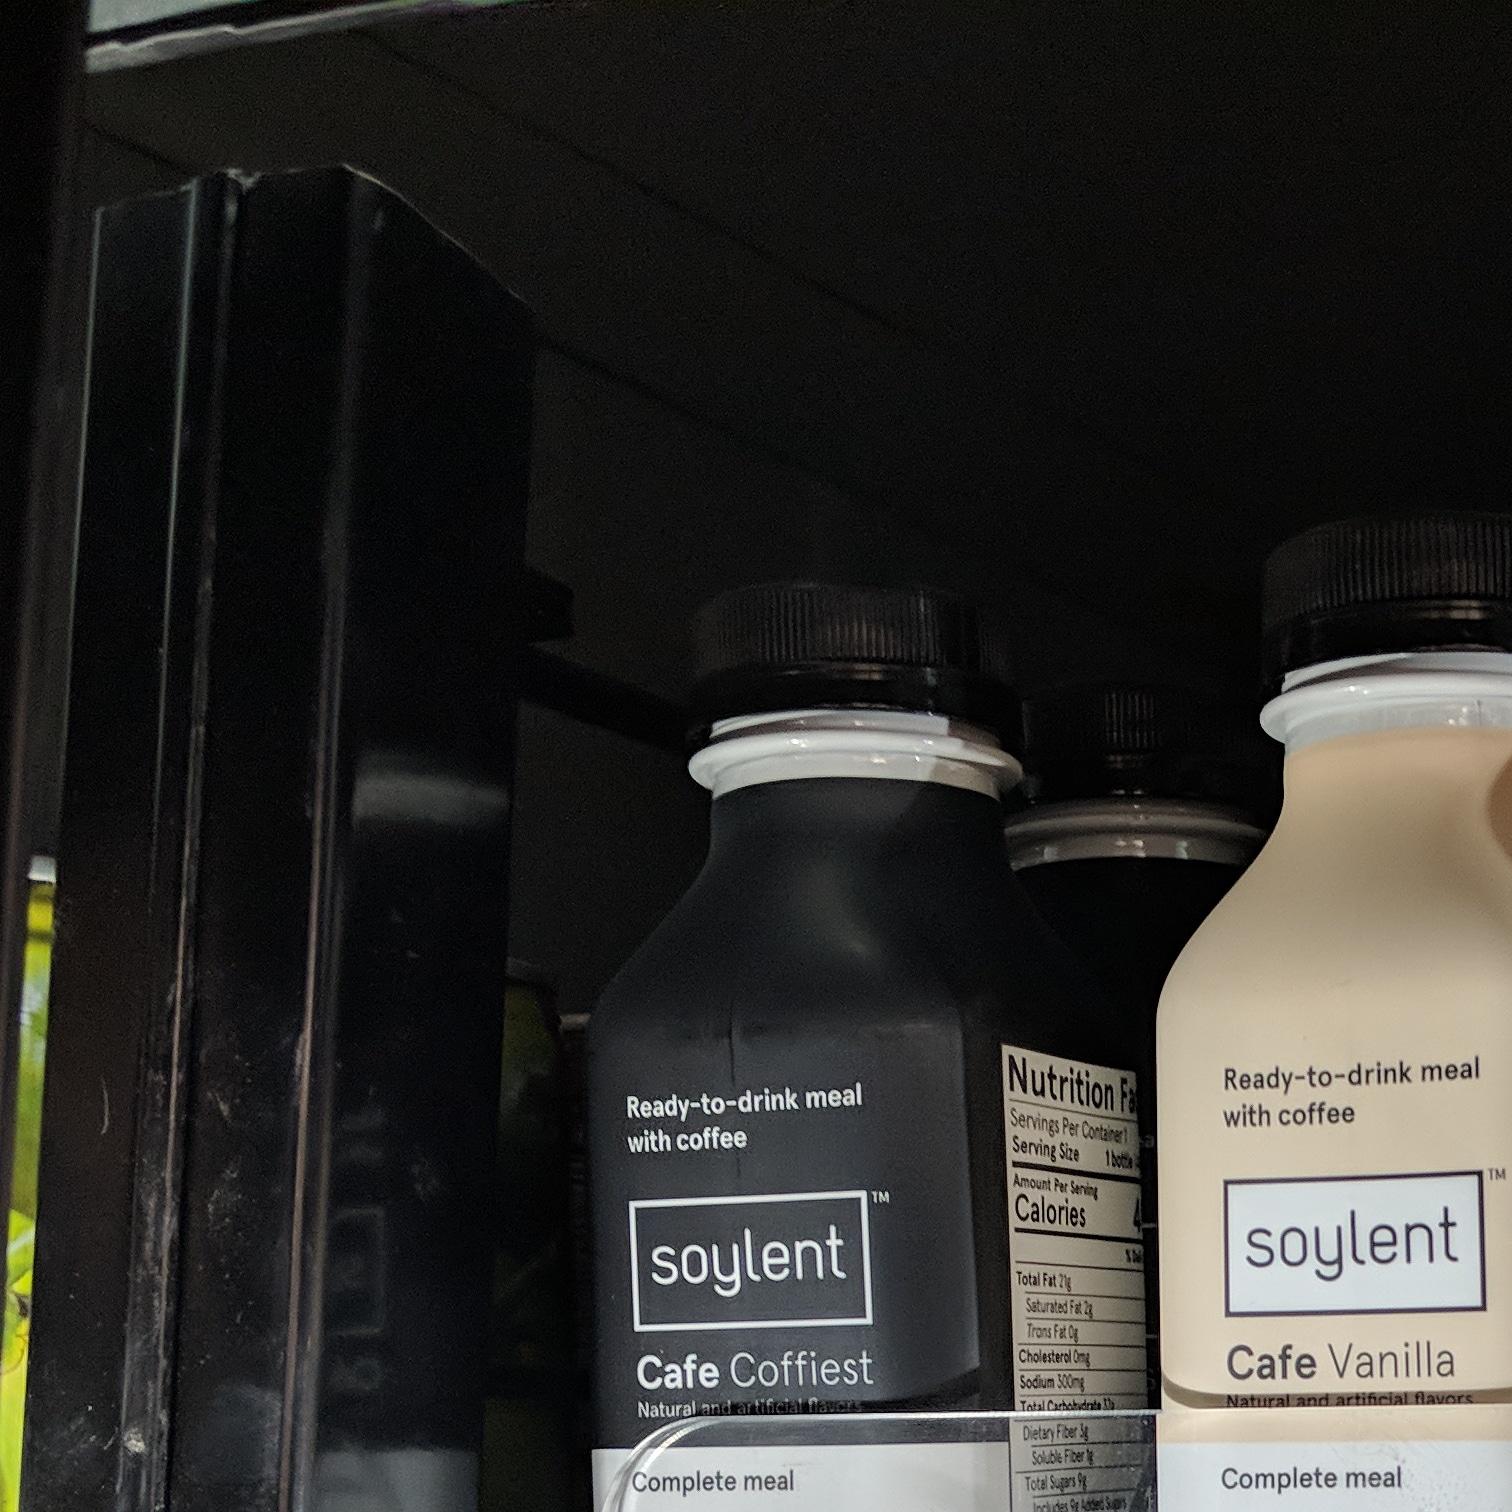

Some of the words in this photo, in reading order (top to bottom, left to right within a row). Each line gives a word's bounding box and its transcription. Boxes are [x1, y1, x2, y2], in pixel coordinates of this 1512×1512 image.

[1008, 1054, 1114, 1111] Nutrition
[1224, 1060, 1413, 1095] Ready-to-drink
[1421, 1056, 1480, 1080] meal
[627, 1089, 799, 1120] Ready-to-drink
[806, 1083, 863, 1109] meal
[1224, 1104, 1270, 1128] with
[1278, 1102, 1355, 1126] coffee
[628, 1129, 671, 1153] with
[676, 1129, 747, 1152] coffee
[1012, 1135, 1057, 1162] Serving
[1059, 1142, 1080, 1161] Size
[1015, 1194, 1086, 1228] Calories
[1246, 1205, 1460, 1282] soylent
[650, 1224, 847, 1298] soylent
[1016, 1271, 1041, 1286] Total
[1042, 1273, 1057, 1287] Fat
[1019, 1349, 1072, 1363] Cholesterol
[1227, 1343, 1317, 1381] Cafe
[1329, 1340, 1456, 1379] Vanilla
[636, 1354, 720, 1391] Cafe
[730, 1350, 874, 1388] Coffiest
[1020, 1374, 1055, 1389] Sodium
[637, 1400, 696, 1418] Natural
[1226, 1394, 1290, 1408] Natural
[1296, 1393, 1329, 1407] and
[1023, 1424, 1054, 1442] Dietary
[632, 1471, 737, 1497] Complete
[743, 1470, 795, 1492] meal
[1222, 1468, 1337, 1494] Complete
[1345, 1466, 1402, 1489] meal
